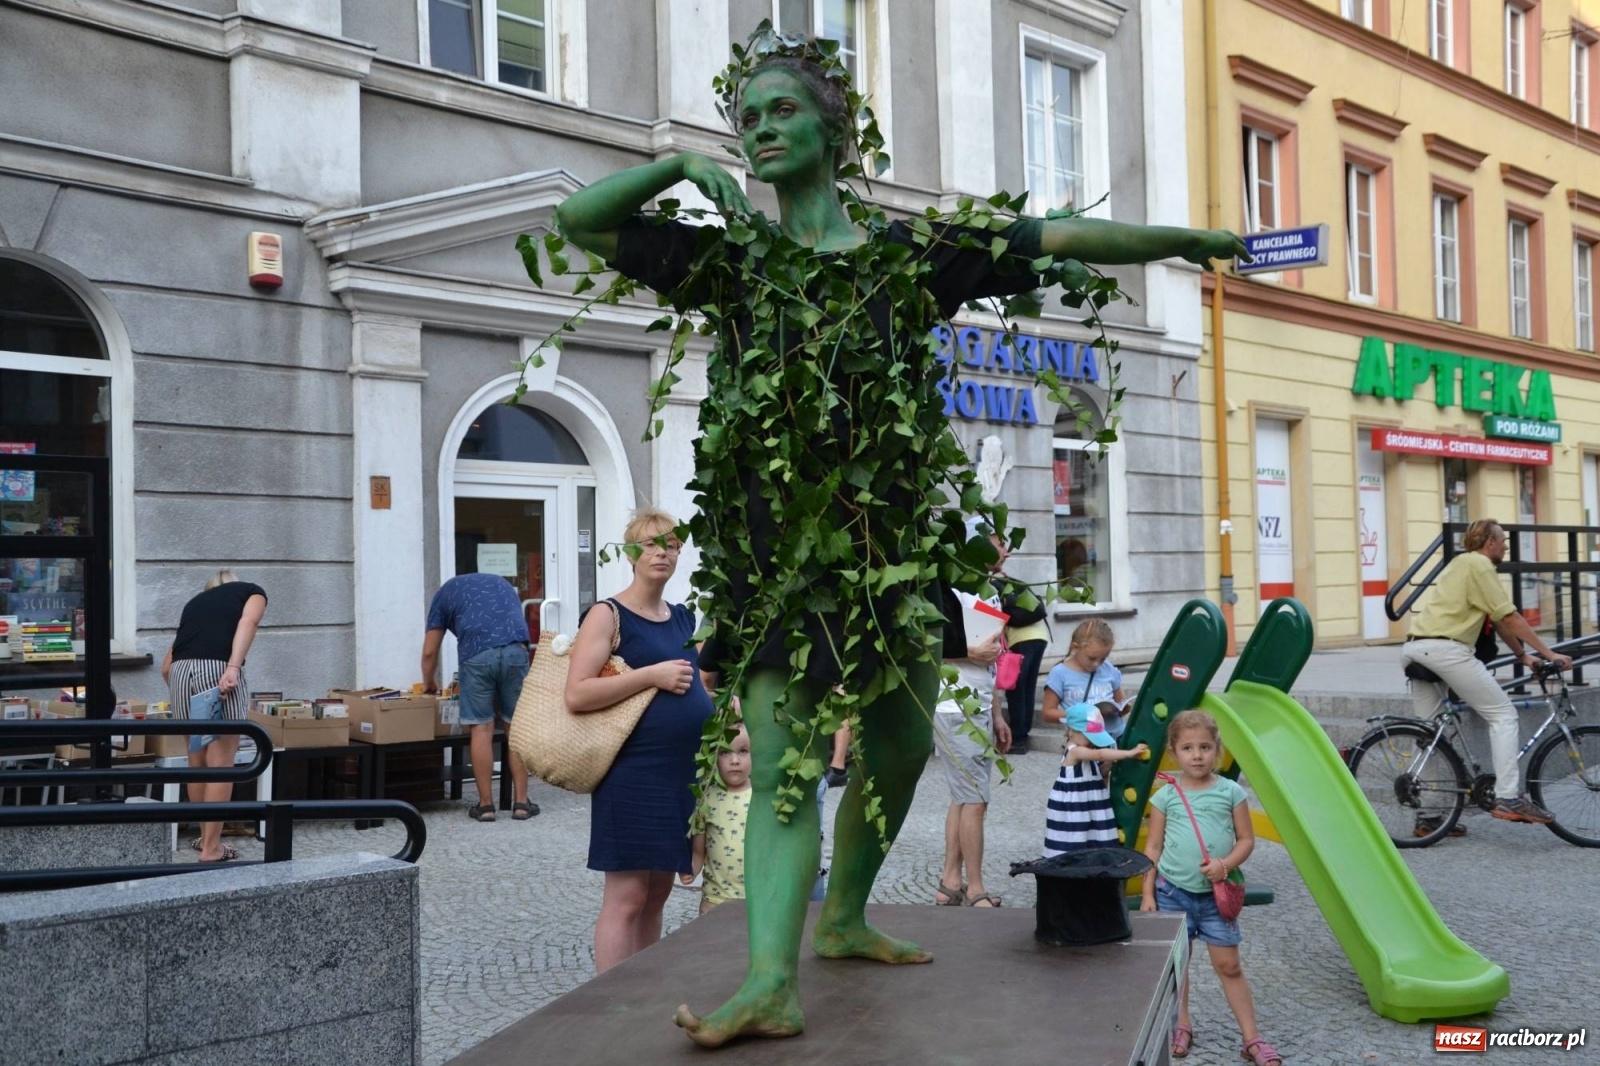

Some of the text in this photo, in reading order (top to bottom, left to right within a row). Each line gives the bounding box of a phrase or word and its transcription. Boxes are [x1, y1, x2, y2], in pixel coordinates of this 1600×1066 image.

[1252, 234, 1303, 251] KANCELARIA
[1267, 246, 1316, 263] PRAWNEGO
[1352, 336, 1557, 421] APTEKA
[1496, 420, 1559, 440] POD RÓŻAMI
[1385, 431, 1444, 451] ŚRÓDMIEJSKA
[1449, 440, 1486, 455] CENTRUM
[1486, 443, 1549, 461] FARMACEUTYCZNE
[1257, 467, 1286, 477] APTEKA
[23, 597, 68, 611] SCYTHE
